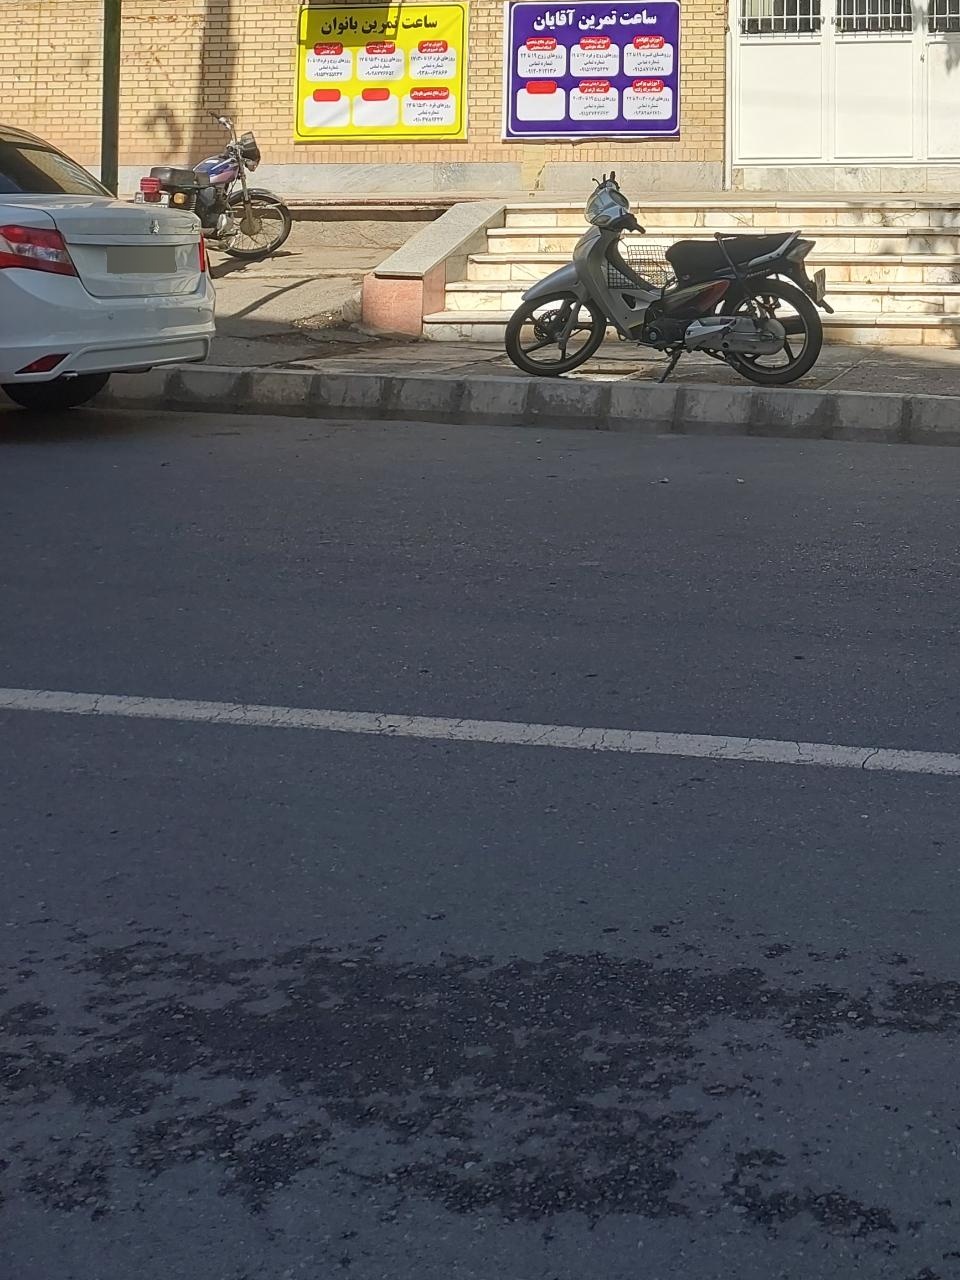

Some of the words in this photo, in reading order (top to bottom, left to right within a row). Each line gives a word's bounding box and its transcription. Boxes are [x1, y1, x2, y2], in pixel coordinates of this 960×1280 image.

[321, 16, 358, 35] بانوان
[362, 16, 399, 34] تمرین
[402, 14, 437, 29] ساعت
[533, 9, 576, 30] آقایان
[578, 10, 617, 30] تمرین
[620, 9, 657, 25] ساعت
